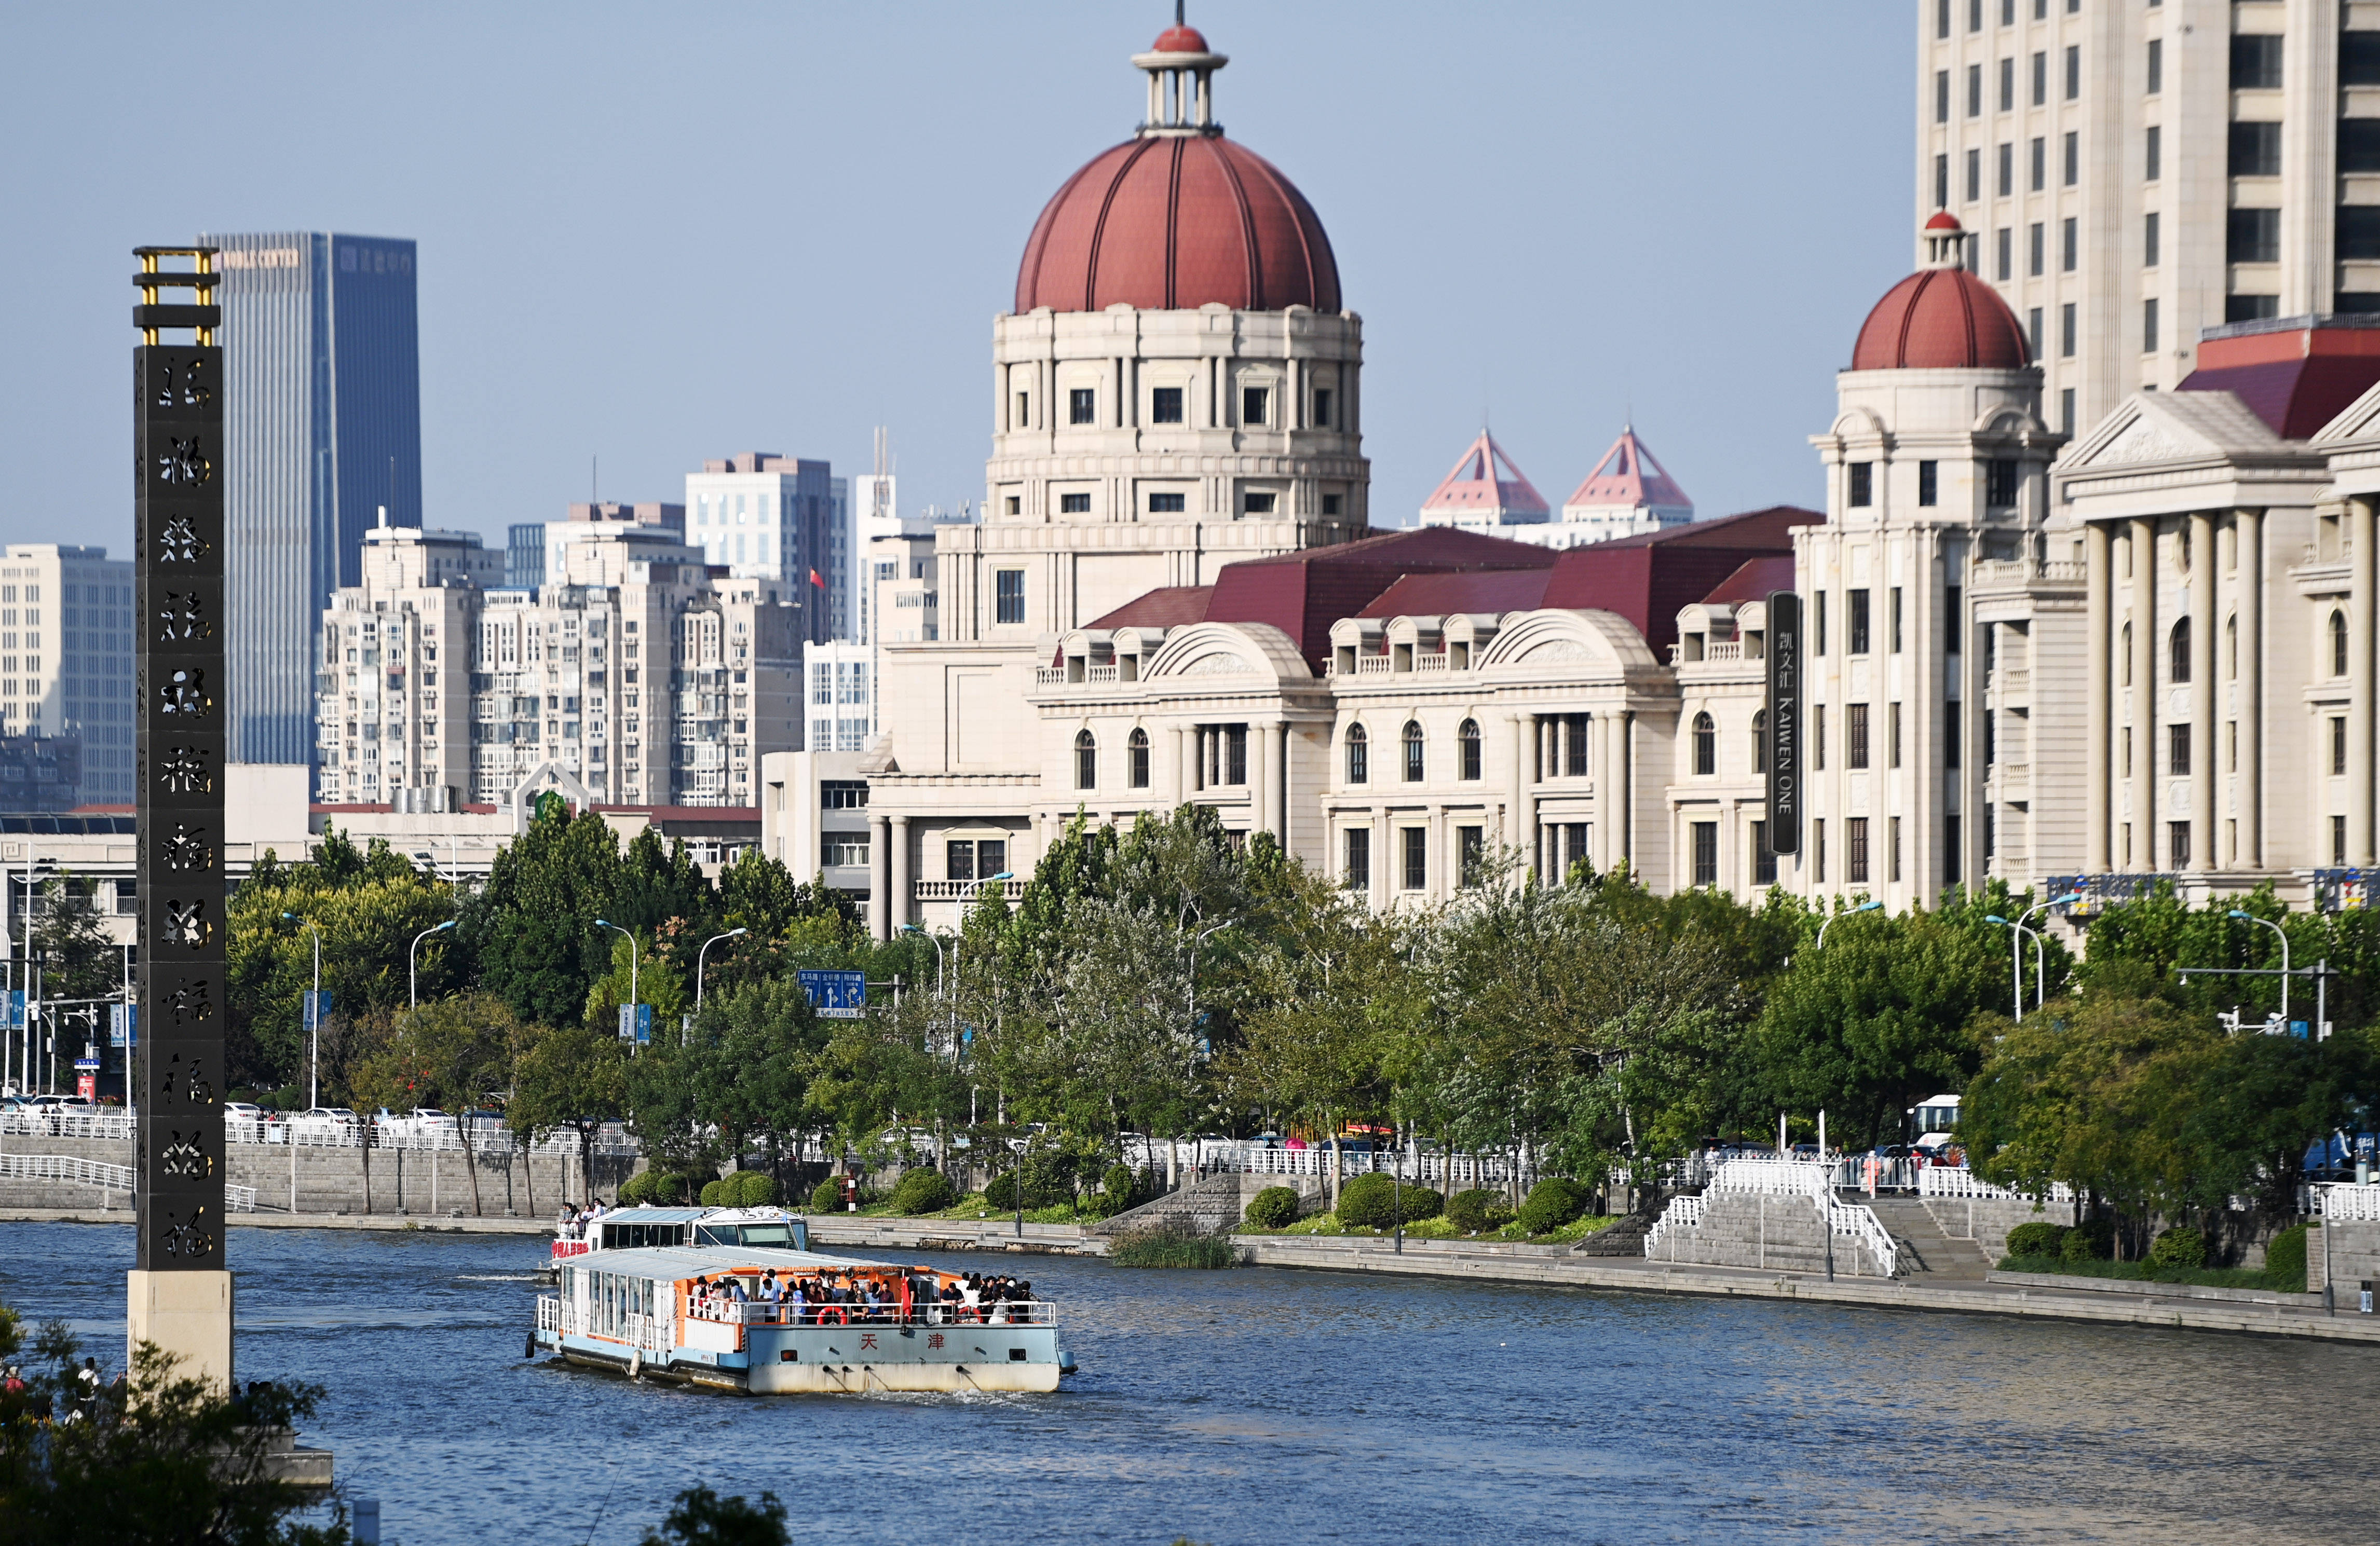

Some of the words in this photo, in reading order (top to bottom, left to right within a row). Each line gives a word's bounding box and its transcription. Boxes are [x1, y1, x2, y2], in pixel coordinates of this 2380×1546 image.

[1779, 632, 1793, 689] 凯文汇
[1779, 697, 1793, 770] KAIWEN
[1778, 776, 1793, 815] ONE
[861, 1333, 944, 1350] 天津
